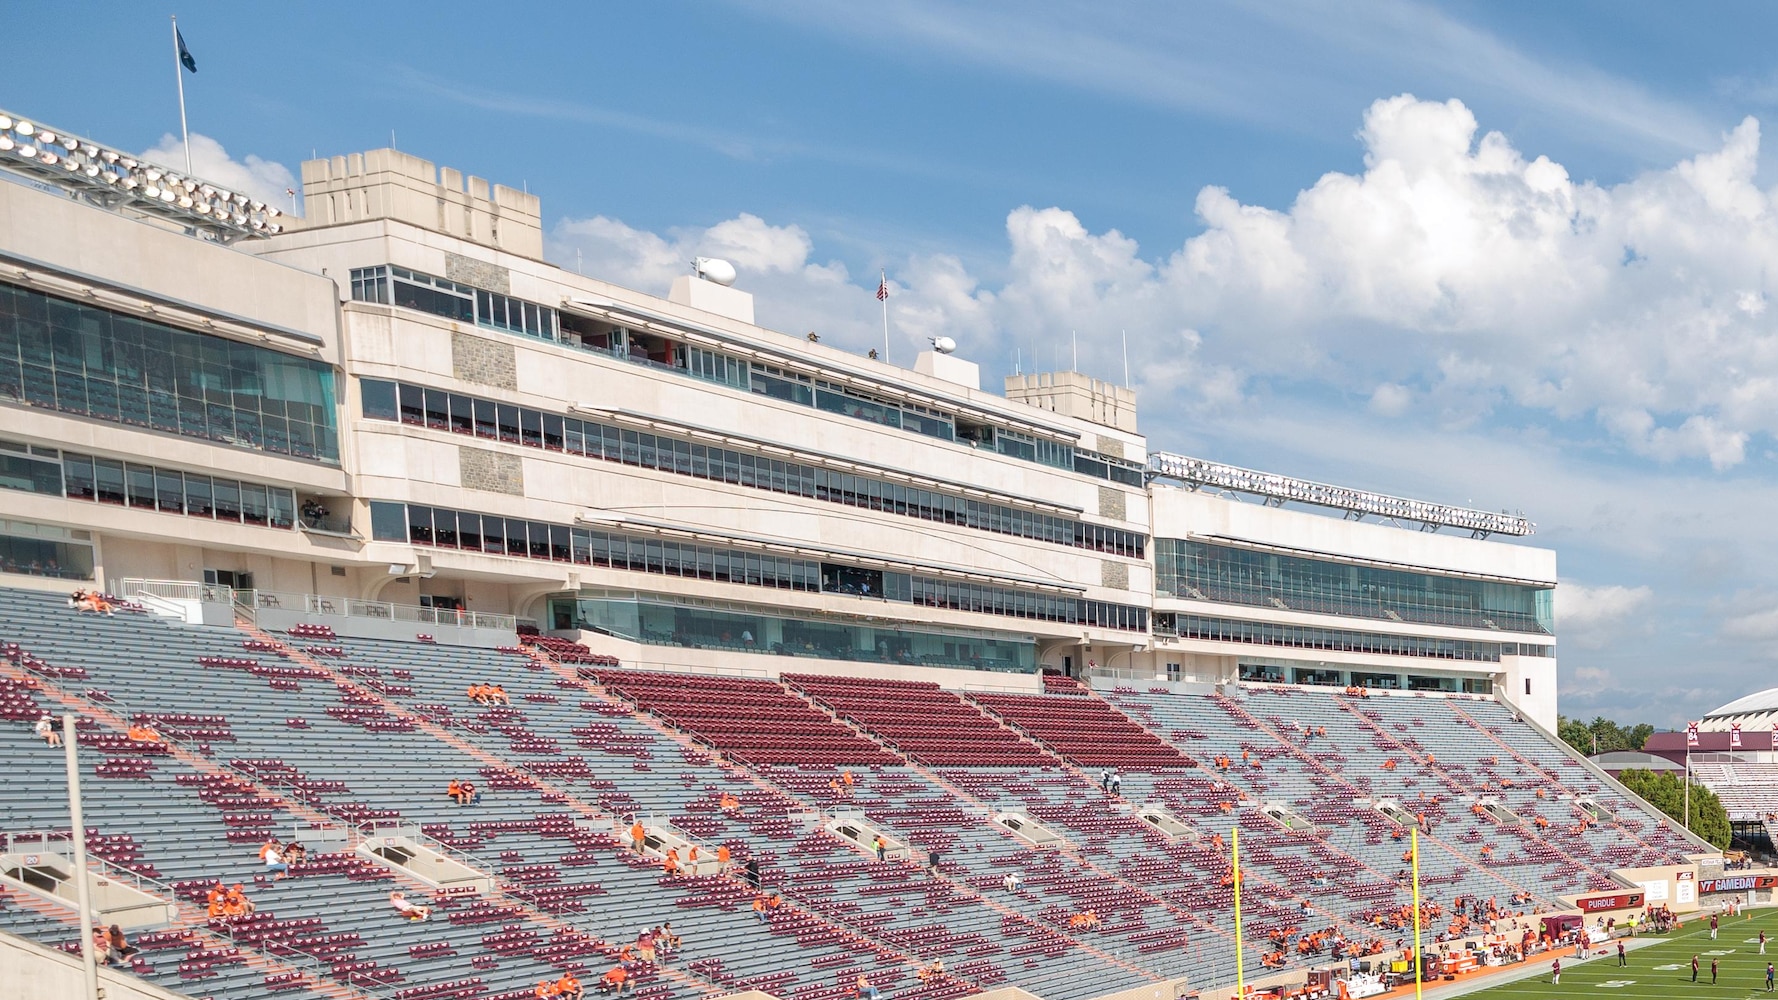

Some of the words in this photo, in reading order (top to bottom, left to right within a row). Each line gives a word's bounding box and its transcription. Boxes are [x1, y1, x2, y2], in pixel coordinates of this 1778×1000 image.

[26, 856, 37, 864] 20
[1700, 881, 1715, 892] VT
[1715, 877, 1756, 891] GAMEDAY
[1588, 898, 1615, 909] PURDUE
